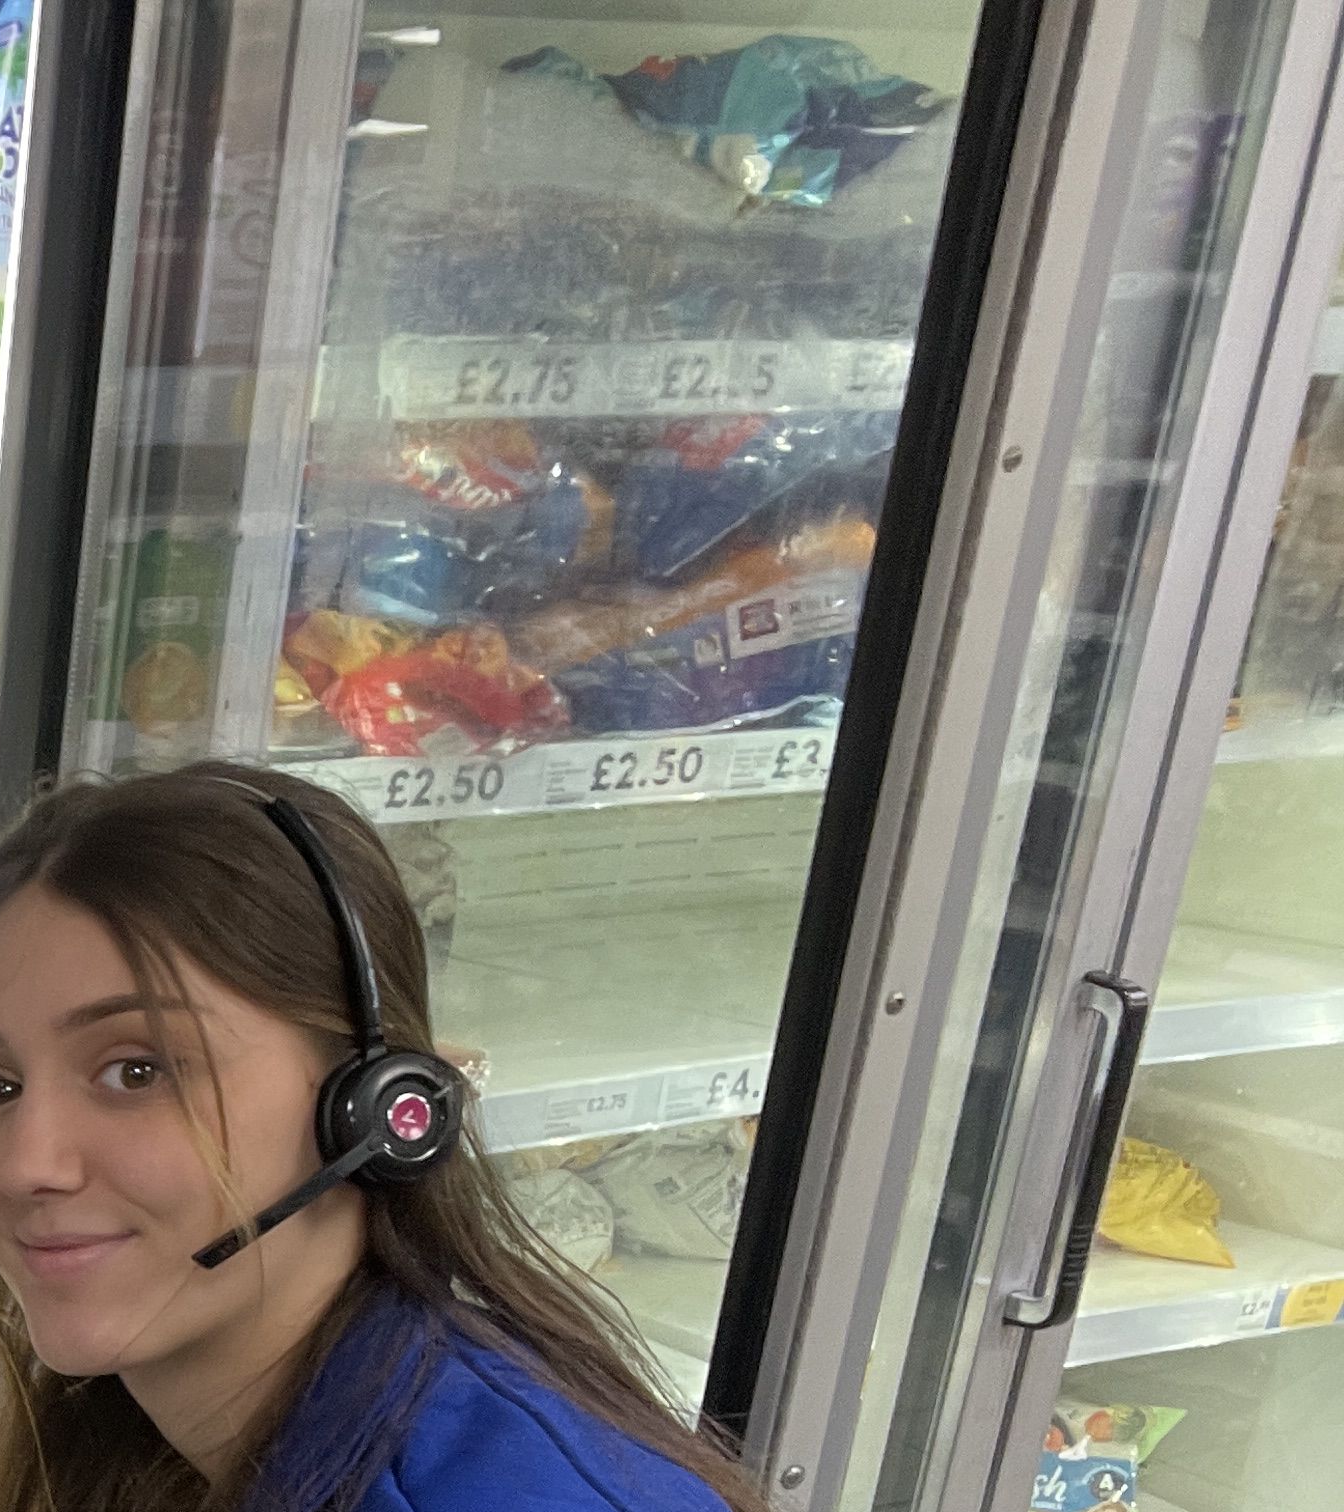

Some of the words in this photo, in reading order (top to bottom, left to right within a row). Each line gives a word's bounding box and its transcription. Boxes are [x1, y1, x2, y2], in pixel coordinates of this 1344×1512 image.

[454, 359, 578, 402] £2.75
[662, 353, 779, 399] £2.5
[384, 762, 505, 809] £2.50
[589, 745, 704, 792] £2.50
